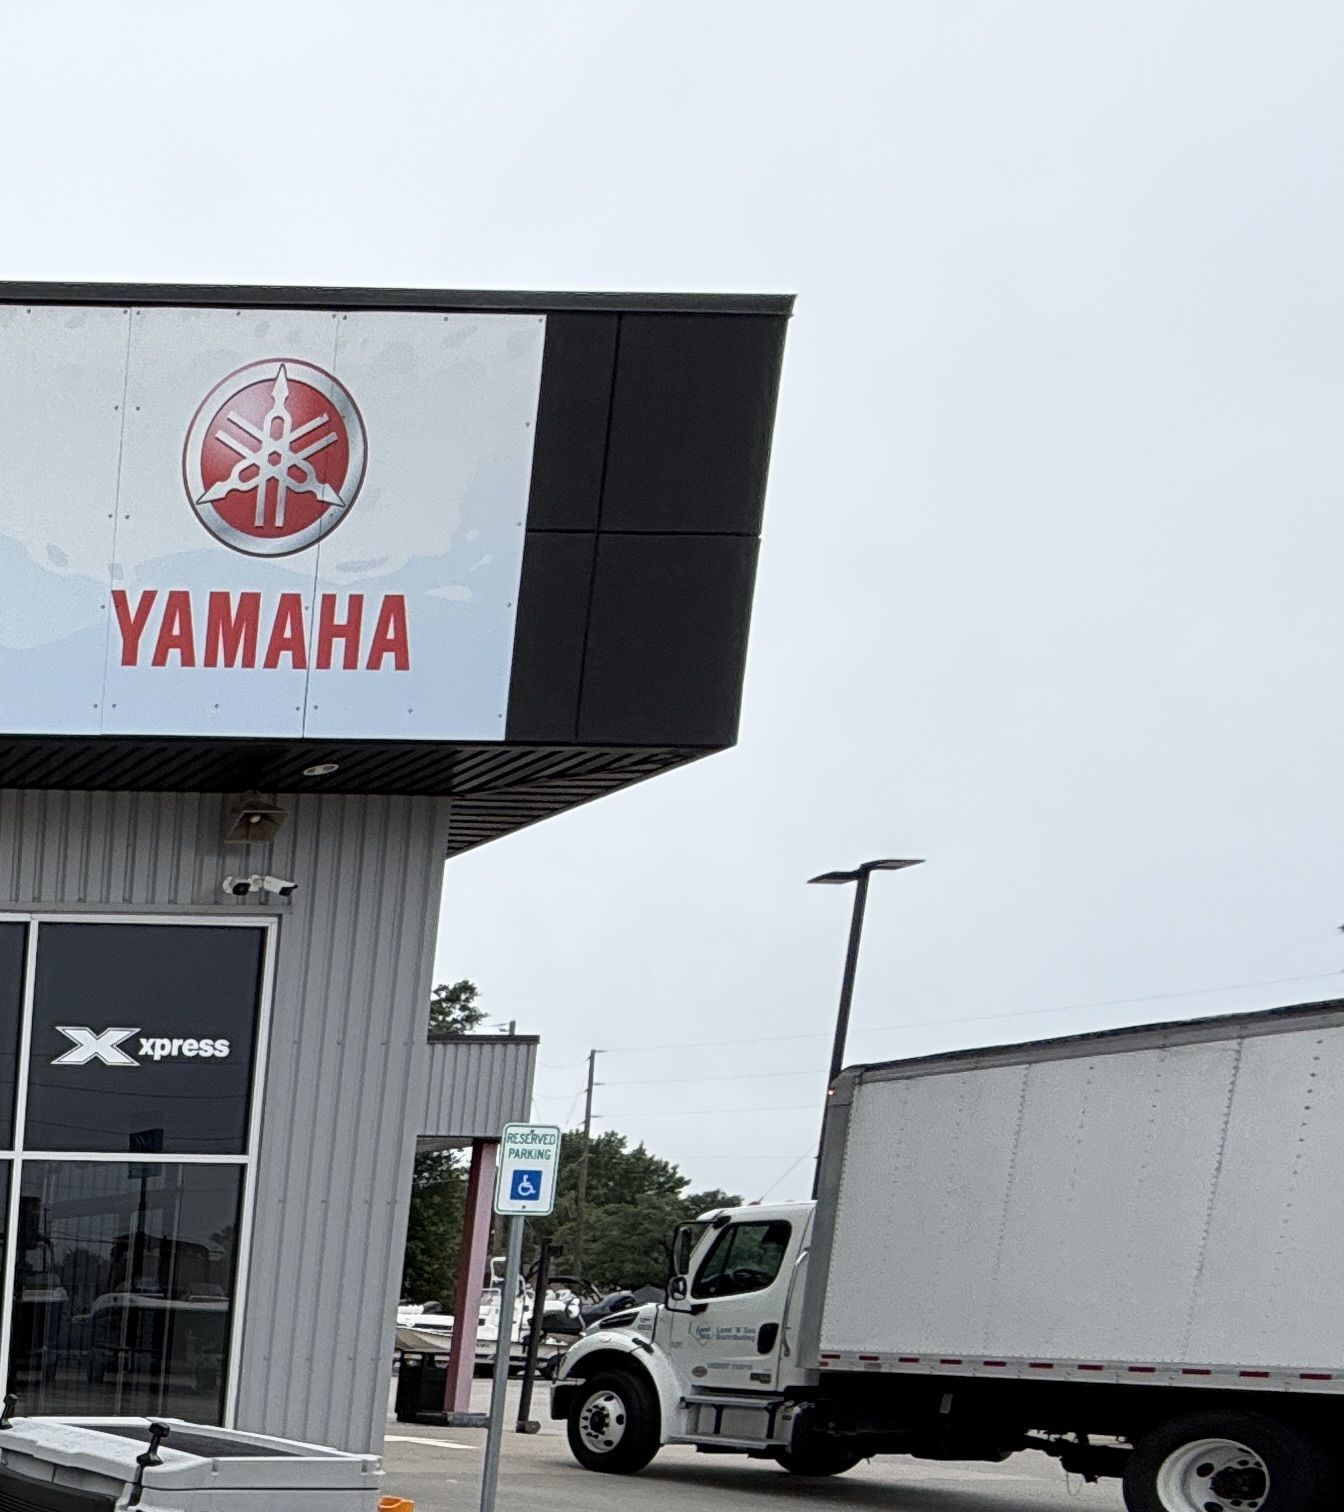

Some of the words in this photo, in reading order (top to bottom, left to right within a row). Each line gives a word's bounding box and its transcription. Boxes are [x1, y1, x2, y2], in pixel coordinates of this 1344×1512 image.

[111, 590, 410, 671] YAMAHA
[138, 1038, 230, 1061] xpress
[506, 1132, 556, 1146] RESERVED
[508, 1147, 552, 1160] PARKING
